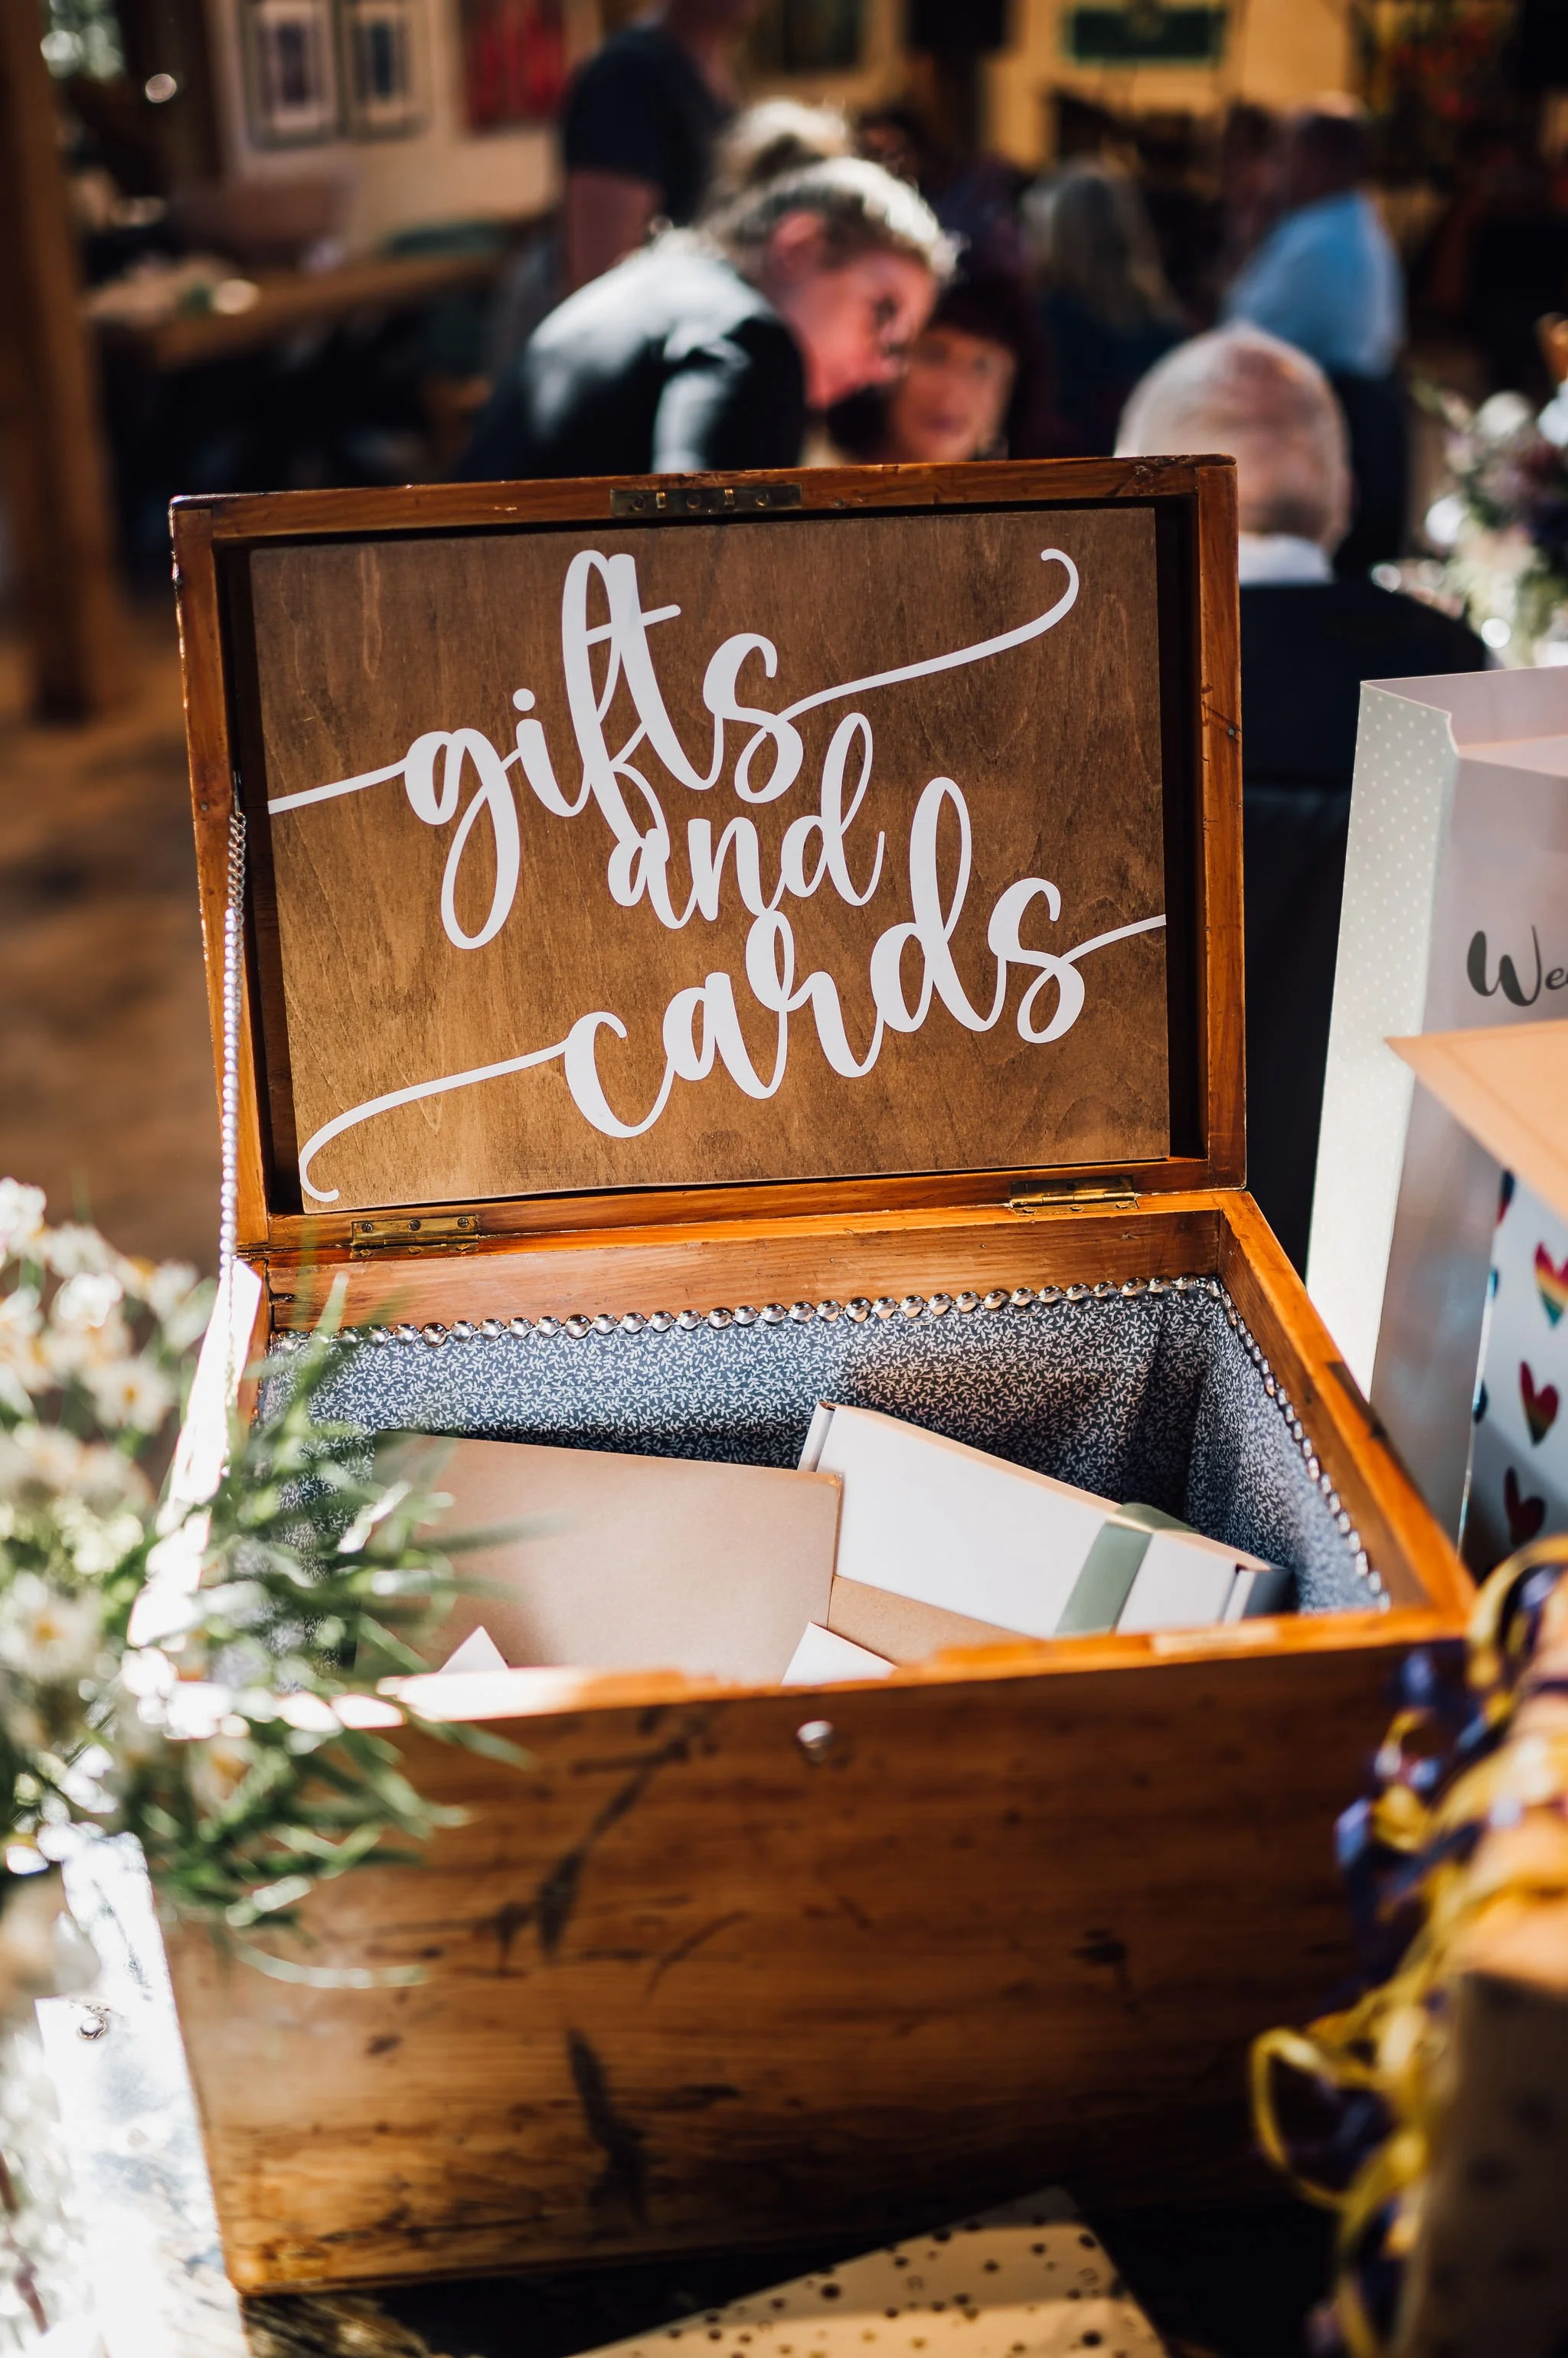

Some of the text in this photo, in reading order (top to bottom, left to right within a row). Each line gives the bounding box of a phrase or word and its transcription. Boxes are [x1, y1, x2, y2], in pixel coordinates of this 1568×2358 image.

[268, 548, 1080, 950] gifts
[608, 712, 885, 929] and
[299, 776, 1166, 1202] cards
[1466, 924, 1568, 1006] We
